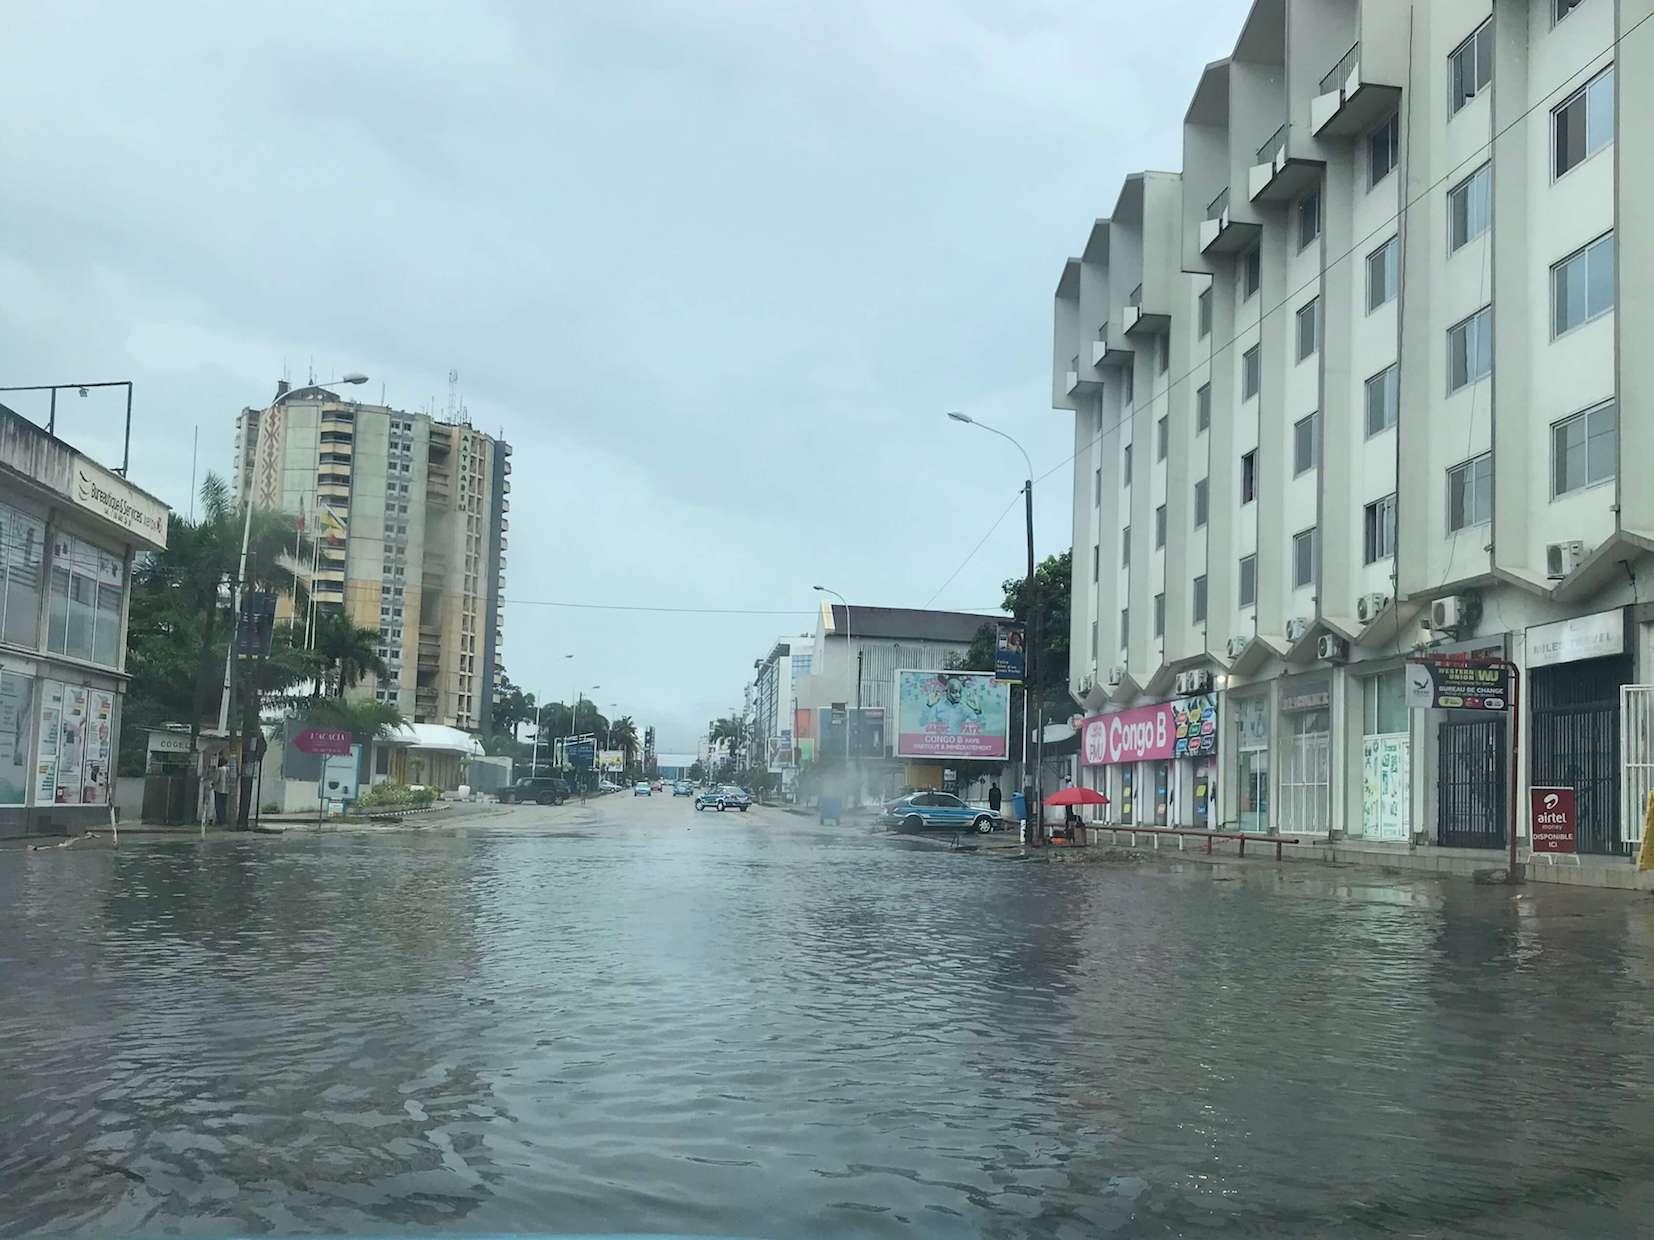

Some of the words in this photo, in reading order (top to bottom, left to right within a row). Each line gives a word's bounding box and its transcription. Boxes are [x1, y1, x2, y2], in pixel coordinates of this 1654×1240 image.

[924, 735, 956, 744] CONGO
[1109, 716, 1154, 761] Congo
[1156, 711, 1167, 748] B
[1537, 812, 1567, 823] airtel
